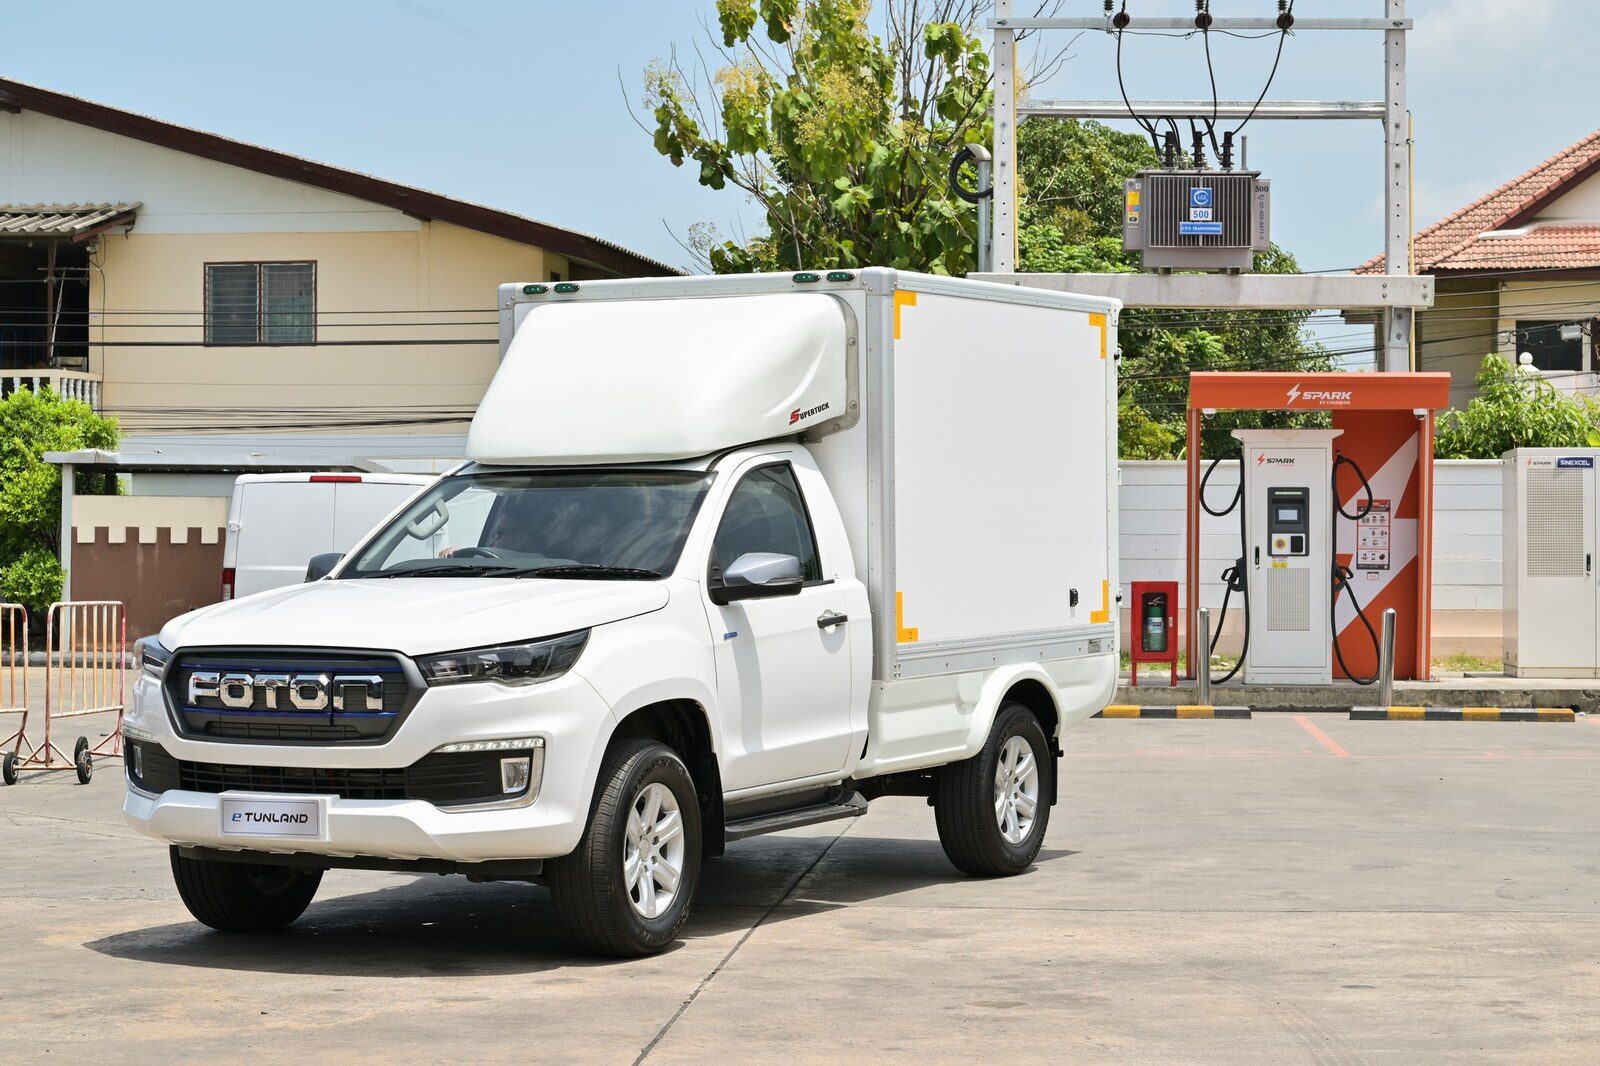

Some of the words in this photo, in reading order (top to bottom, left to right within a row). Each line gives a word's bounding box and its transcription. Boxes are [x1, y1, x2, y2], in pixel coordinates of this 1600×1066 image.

[1255, 185, 1269, 193] 500
[1193, 210, 1209, 219] 500
[1301, 391, 1353, 400] SPARK
[788, 402, 830, 426] SUPERTUCK
[188, 671, 385, 711] FOTON
[244, 812, 309, 824] TUNLAND
